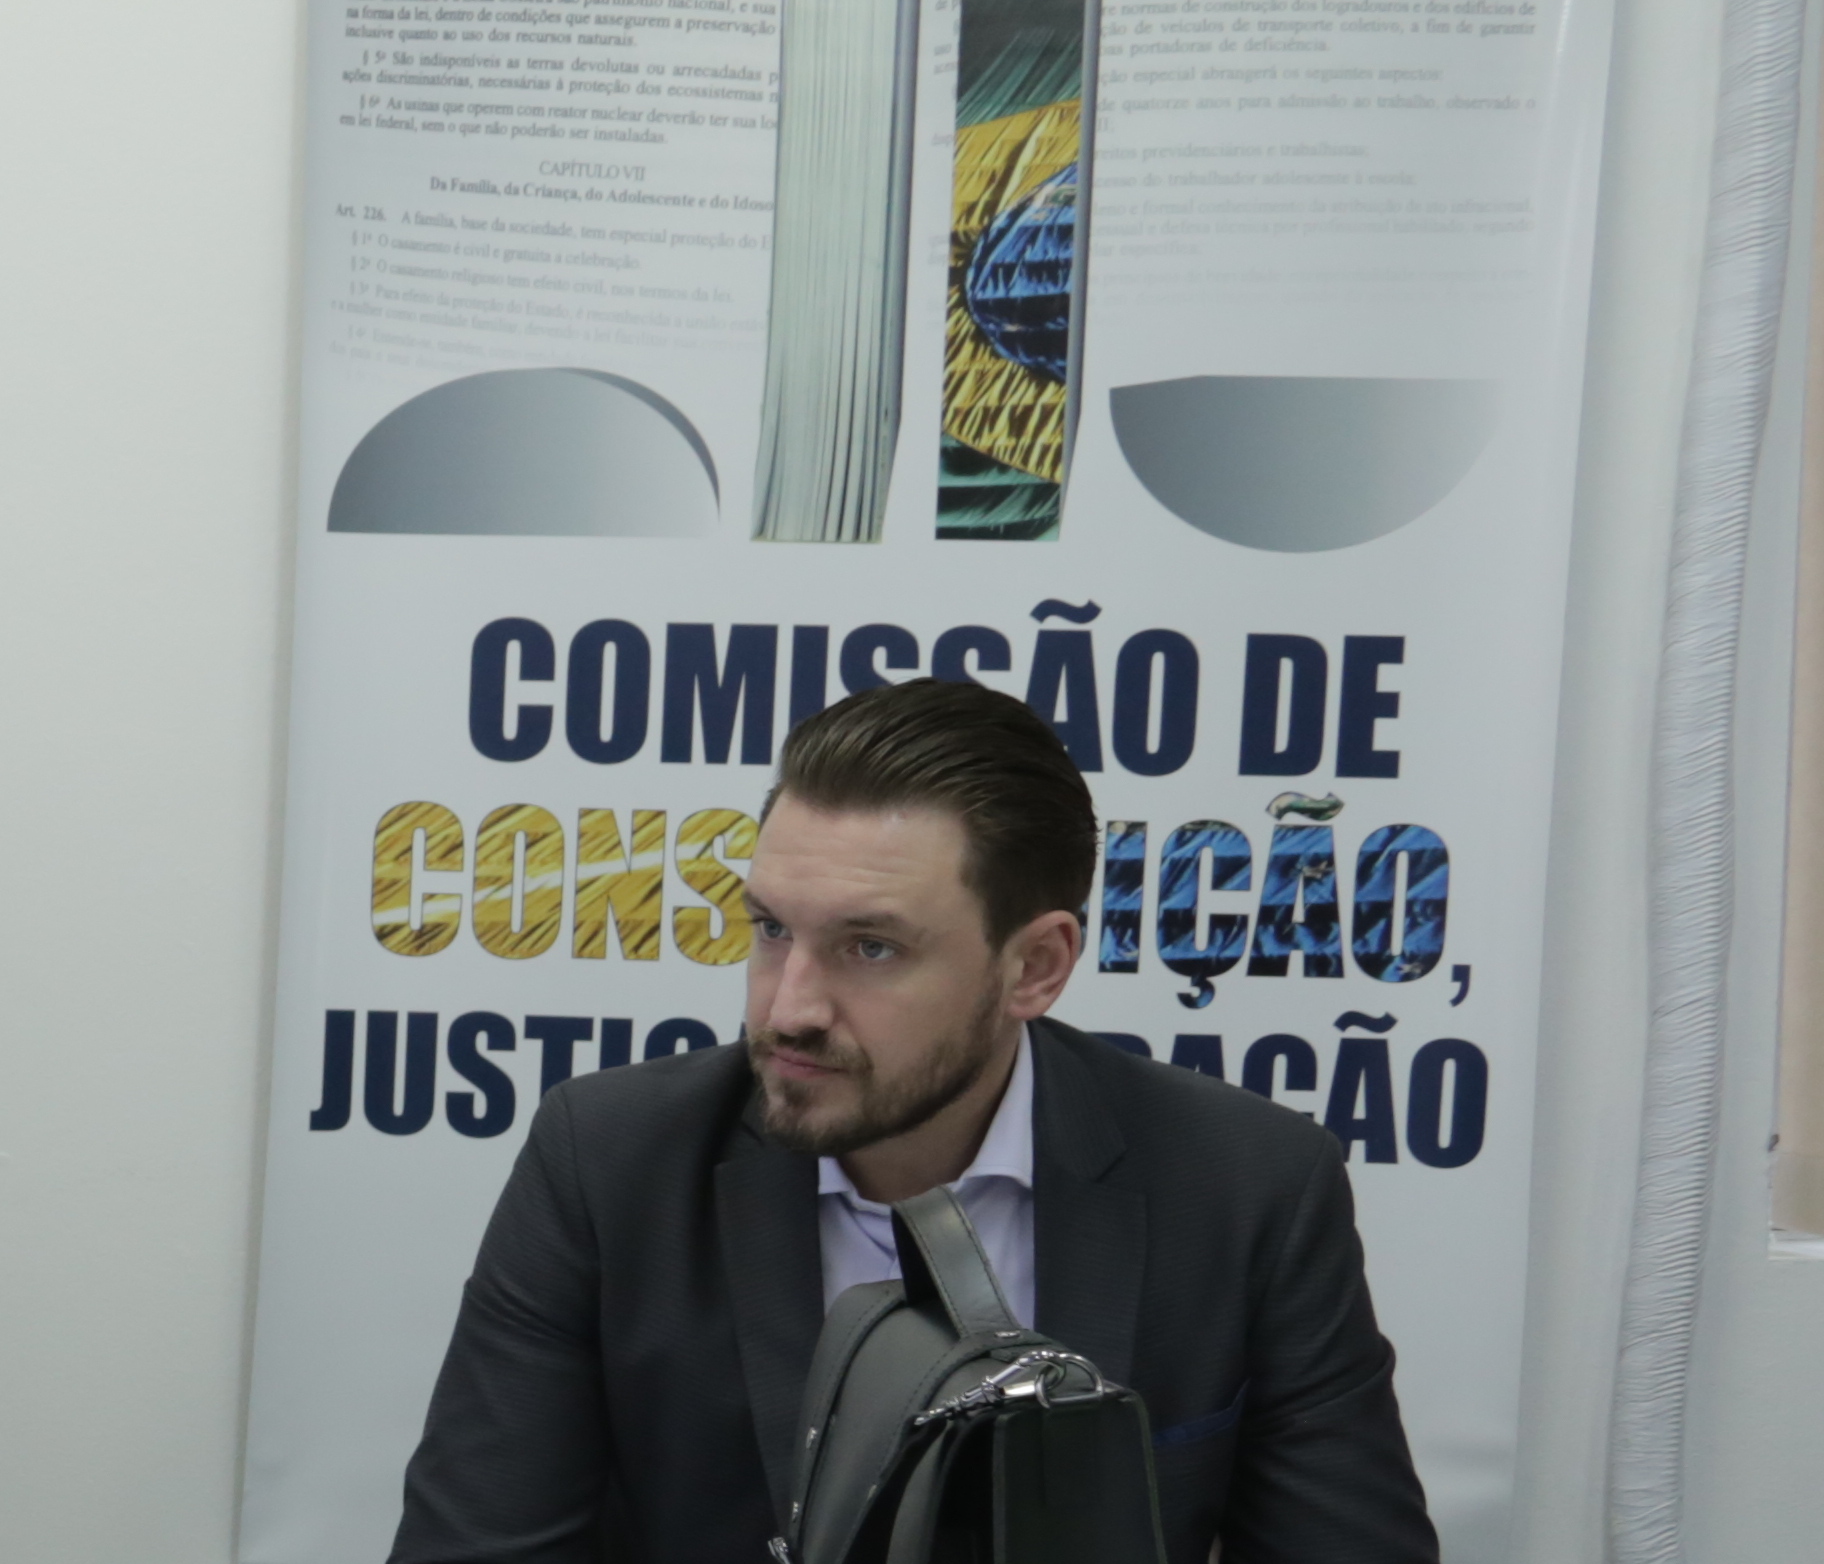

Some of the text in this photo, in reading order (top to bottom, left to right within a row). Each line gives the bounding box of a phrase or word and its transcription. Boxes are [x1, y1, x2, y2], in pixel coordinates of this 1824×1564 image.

[398, 8, 410, 20] da
[436, 9, 473, 21] dentro
[478, 9, 491, 21] de
[496, 9, 561, 25] condições
[566, 14, 590, 27] que
[595, 14, 670, 29] assegurem
[674, 19, 682, 27] a
[687, 18, 776, 36] preservação
[399, 29, 437, 42] quanto
[462, 32, 483, 41] uso
[489, 29, 510, 41] dos
[516, 32, 571, 43] recursos
[1219, 37, 1236, 51] de
[393, 52, 414, 65] São
[420, 53, 499, 69] indisponíveis
[507, 58, 519, 68] as
[527, 58, 563, 69] terras
[571, 57, 639, 73] devolutas
[647, 64, 665, 74] ou
[673, 64, 761, 80] arrecadadas
[479, 76, 550, 90] necessárias
[569, 80, 629, 95] proteção
[636, 81, 661, 95] dos
[667, 84, 763, 101] ecossistemas
[359, 113, 371, 127] lei
[422, 120, 444, 132] sem
[448, 123, 456, 132] o
[460, 123, 481, 136] que
[486, 122, 507, 135] não
[511, 123, 564, 139] poderão
[569, 128, 588, 139] ser
[388, 97, 401, 110] As
[443, 103, 464, 115] que
[467, 103, 512, 117] operem
[517, 104, 544, 116] com
[548, 105, 587, 119] reator
[591, 106, 643, 122] nuclear
[647, 108, 705, 126] deverão
[710, 113, 729, 127] ter
[733, 117, 756, 128] sua
[539, 158, 620, 179] CAPÍTULO
[431, 177, 446, 191] Da
[450, 178, 500, 196] Família,
[504, 182, 519, 196] da
[523, 183, 582, 202] Criança,
[585, 188, 603, 201] do
[606, 189, 693, 207] Adolescente
[699, 197, 706, 207] e
[710, 195, 728, 209] do
[491, 218, 505, 232] da
[581, 226, 606, 238] tem
[610, 229, 666, 244] especial
[671, 232, 735, 250] proteção
[739, 234, 757, 248] do
[464, 244, 490, 258] civil
[1238, 632, 1406, 779] DE
[371, 792, 1471, 1009] CONSIÇÃO,
